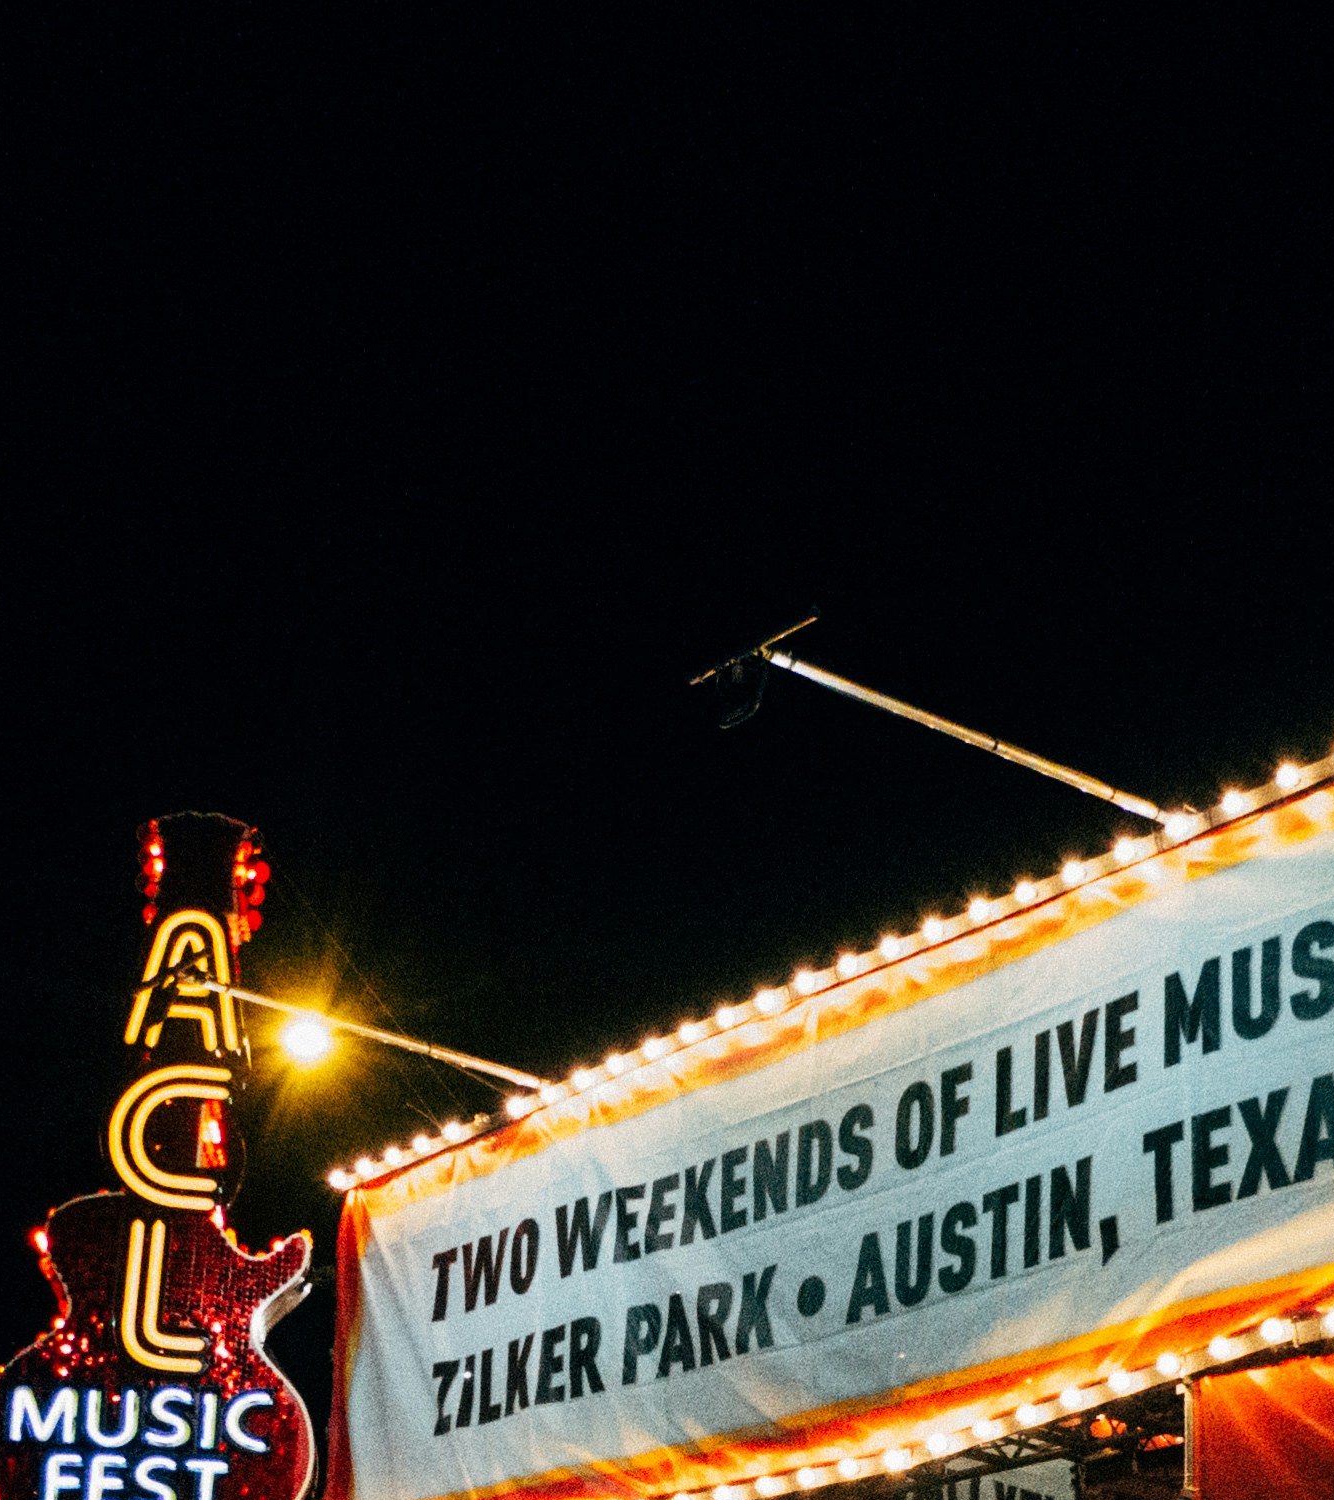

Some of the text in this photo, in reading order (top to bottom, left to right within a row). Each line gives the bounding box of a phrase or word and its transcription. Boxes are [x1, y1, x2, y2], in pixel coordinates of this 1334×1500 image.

[108, 909, 238, 1373] ACL
[431, 1218, 540, 1322] TWO
[555, 1102, 875, 1279] WEEKENDS
[894, 1061, 973, 1171] OF
[995, 990, 1139, 1137] LIVE
[8, 1384, 274, 1454] MUSIC
[432, 1316, 606, 1437] ZILKER
[621, 1263, 779, 1386] PARK
[845, 1155, 1120, 1326] AUSTIN,
